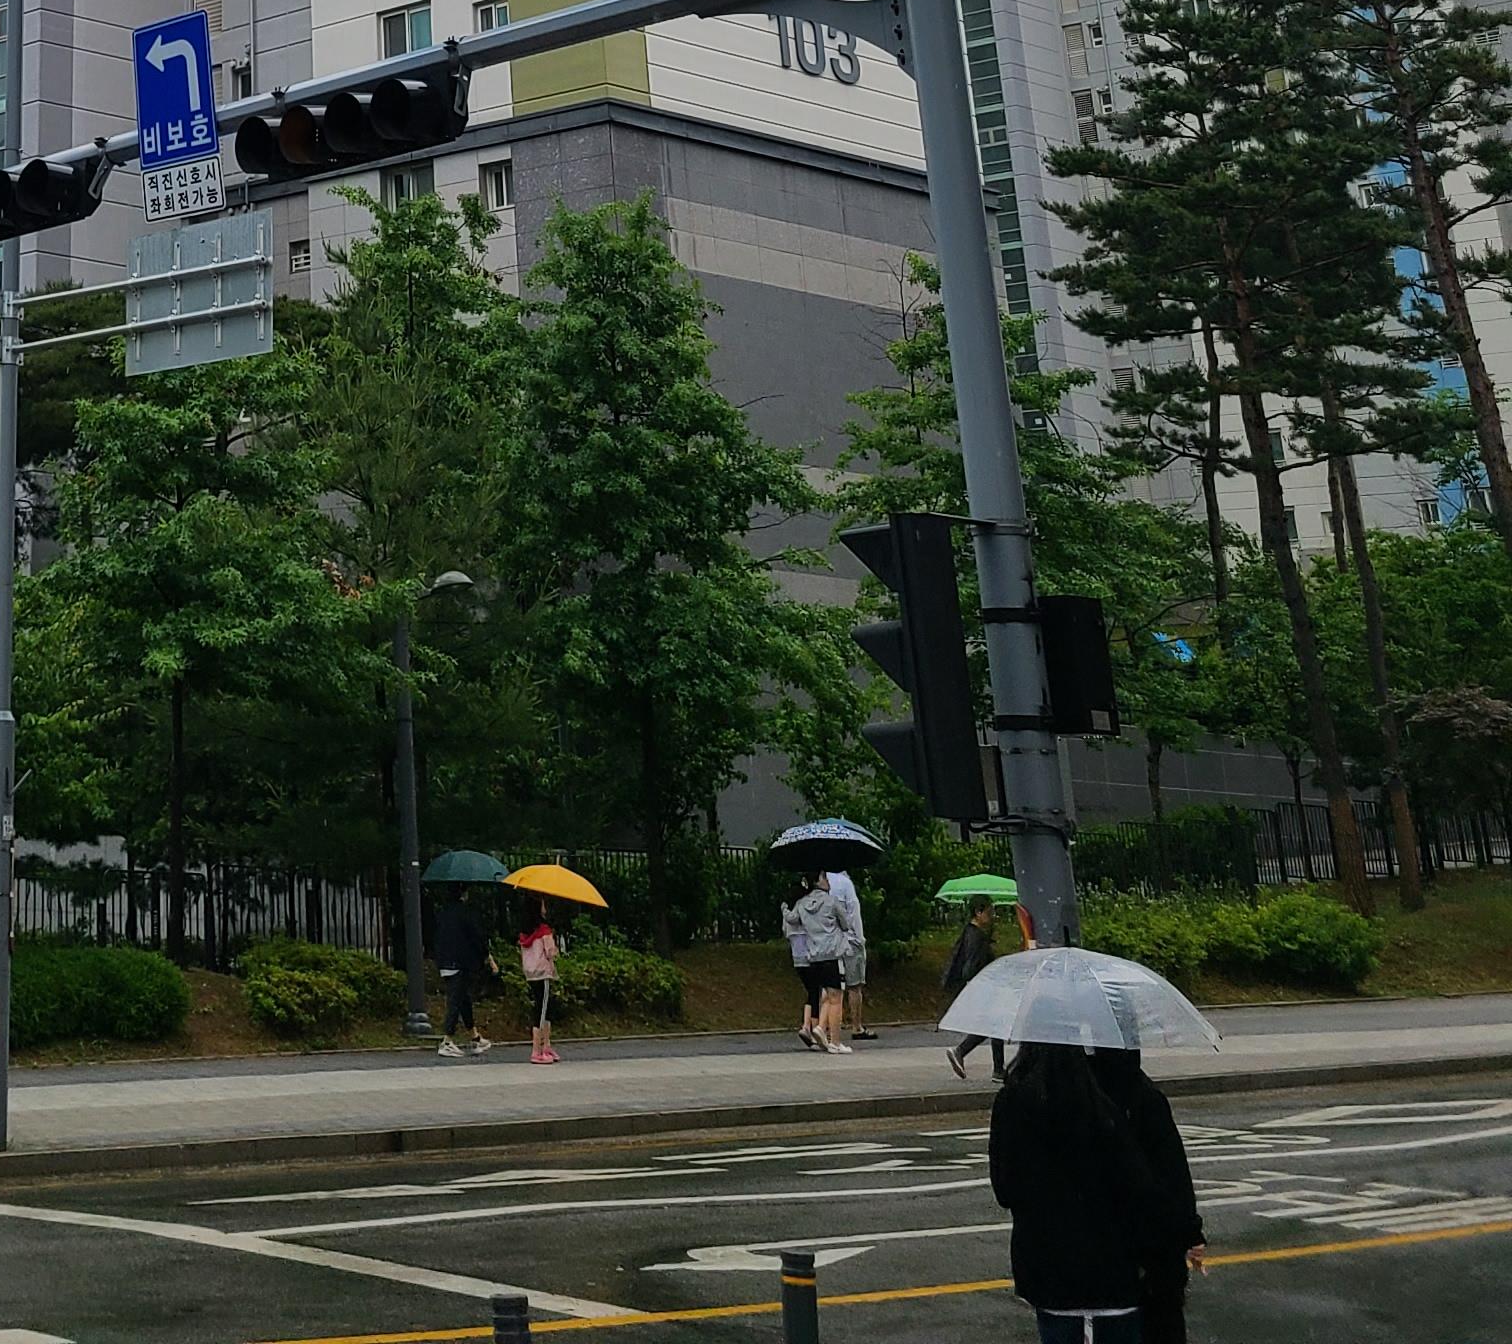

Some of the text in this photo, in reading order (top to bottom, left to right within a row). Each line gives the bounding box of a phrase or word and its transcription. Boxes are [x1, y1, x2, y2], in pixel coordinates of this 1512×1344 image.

[768, 14, 861, 85] 103
[144, 115, 212, 156] 비보호
[148, 163, 216, 193] 직진신호시
[150, 186, 218, 214] 좌회전가능
